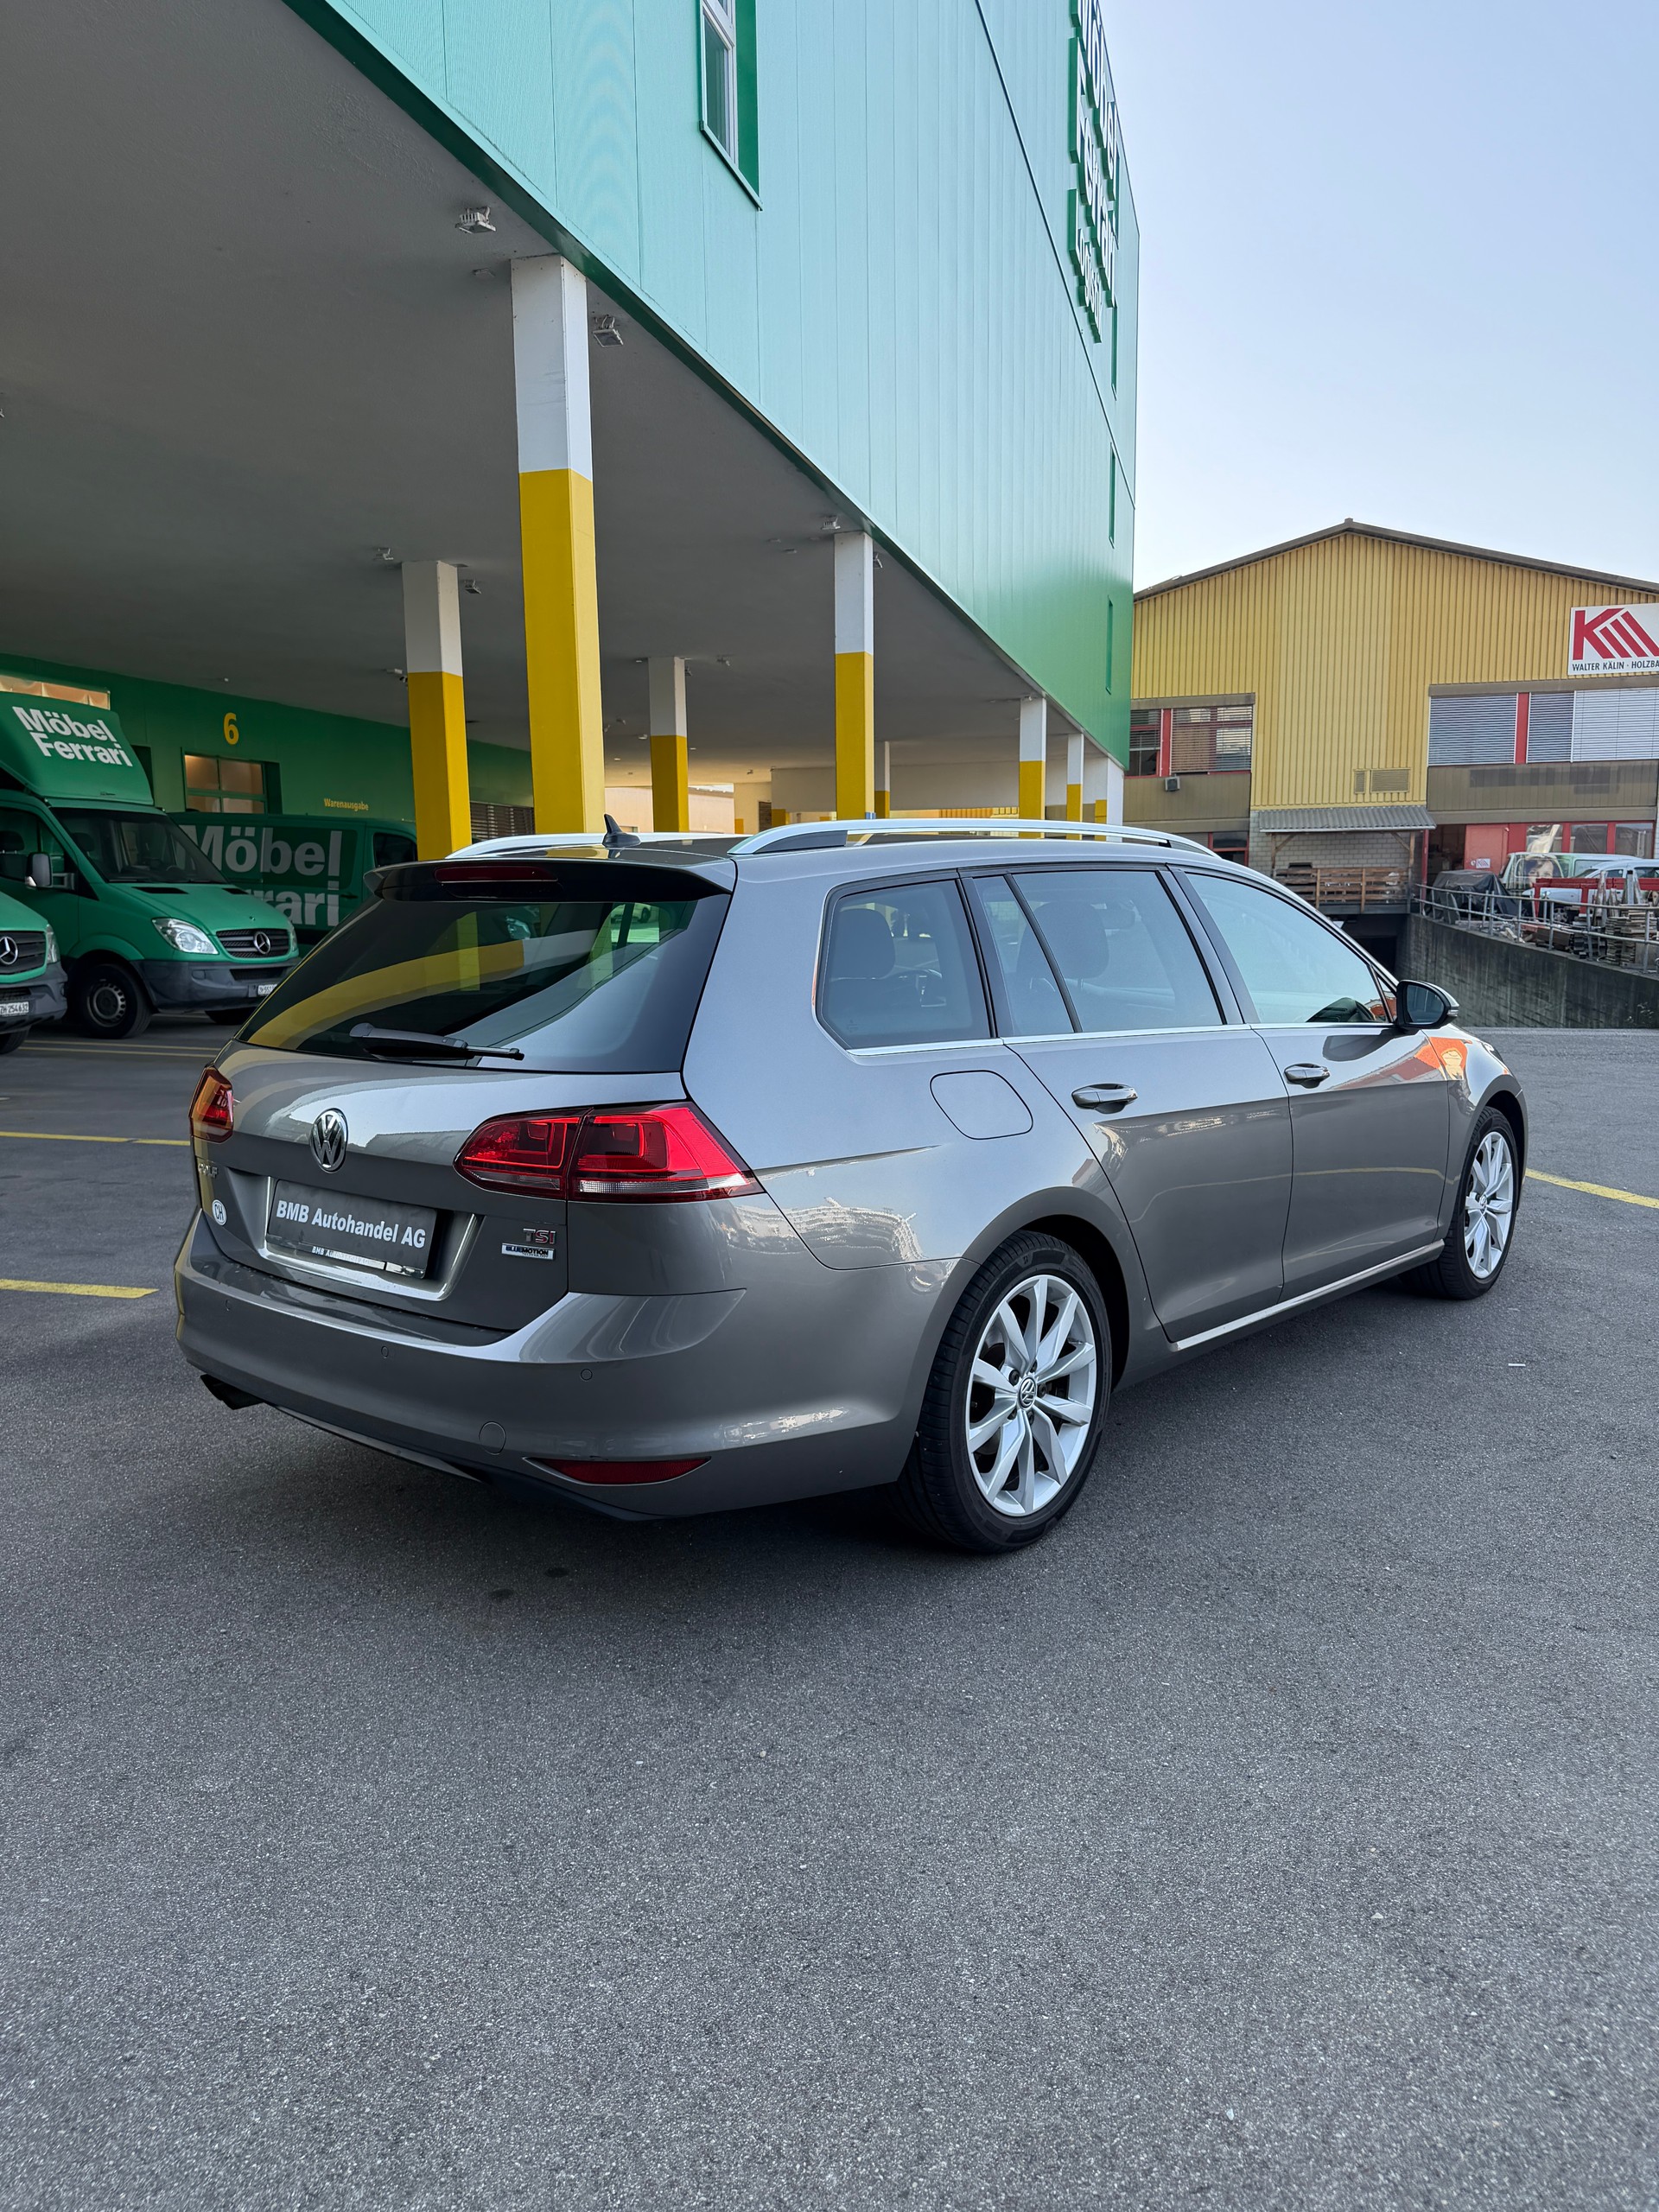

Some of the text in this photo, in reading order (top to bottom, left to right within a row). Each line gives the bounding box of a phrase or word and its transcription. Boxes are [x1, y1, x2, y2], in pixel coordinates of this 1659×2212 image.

[1076, 36, 1116, 308] Ferrari
[1075, 189, 1103, 343] Logistik
[1572, 663, 1599, 671] WALTER
[1603, 660, 1624, 671] KÄLIN
[12, 706, 118, 742] Möbel
[223, 712, 239, 745] 6
[29, 732, 133, 767] Ferrari
[324, 798, 369, 812] Warenausgabe
[213, 1203, 226, 1222] CH
[276, 1199, 426, 1249] BMB Autohandel AG
[311, 1246, 325, 1255] BMB
[523, 1228, 556, 1244] TSI
